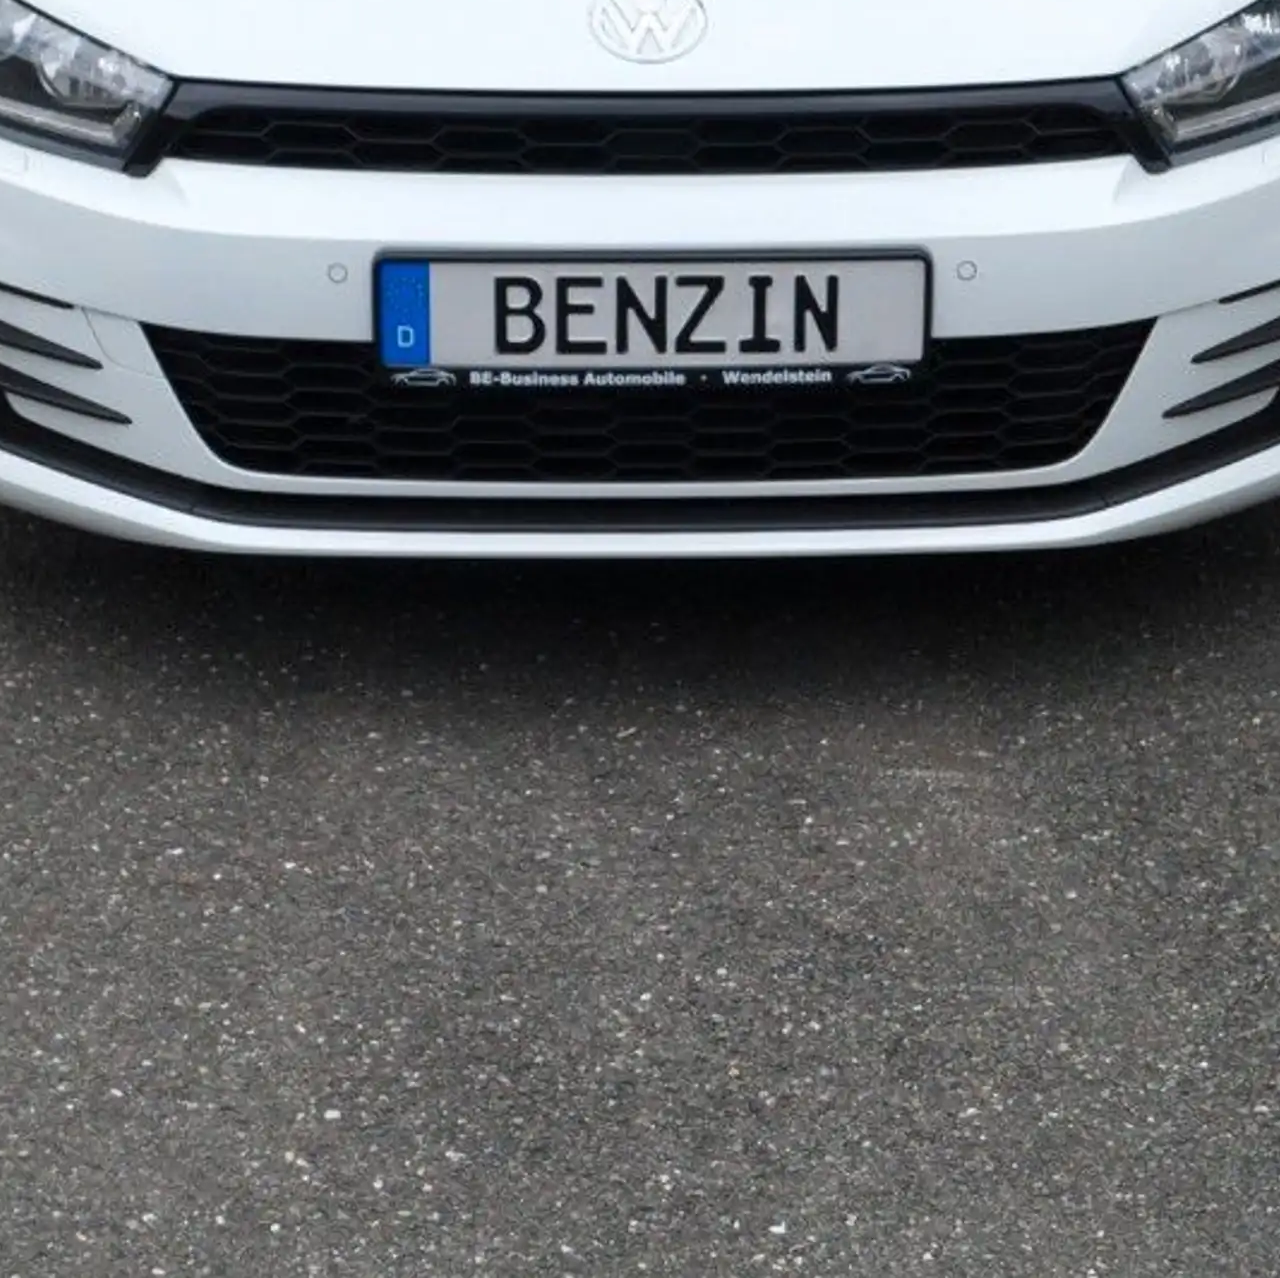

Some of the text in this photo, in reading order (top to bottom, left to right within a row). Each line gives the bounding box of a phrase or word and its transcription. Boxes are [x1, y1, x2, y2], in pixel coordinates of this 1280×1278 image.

[397, 275, 840, 356] D BENZIN
[469, 369, 833, 387] BE-Business Automobile Wendelstein
